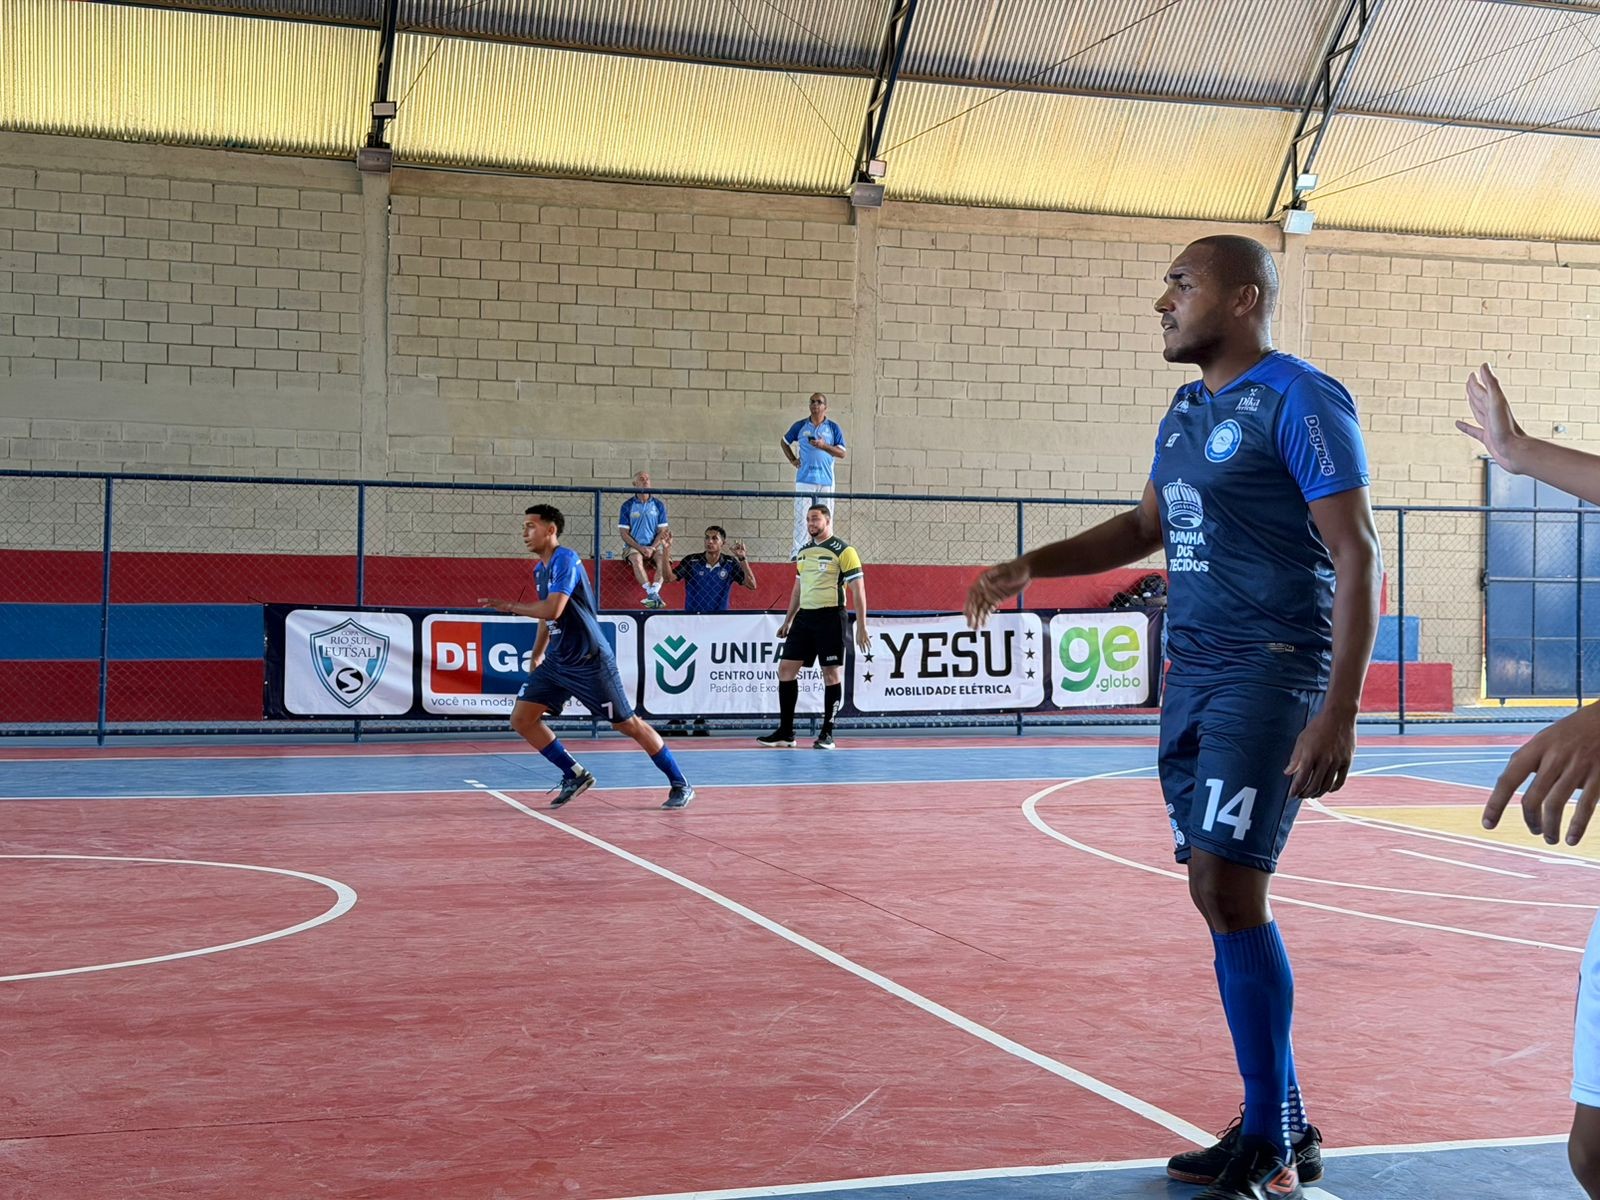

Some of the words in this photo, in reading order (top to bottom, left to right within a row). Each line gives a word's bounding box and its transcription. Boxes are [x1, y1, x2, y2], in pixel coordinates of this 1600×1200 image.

[1168, 558, 1210, 573] TECIDOS
[330, 636, 350, 646] RIO
[350, 636, 370, 646] SUL
[324, 645, 376, 658] FUTSAL
[436, 641, 478, 672] Di
[880, 630, 1015, 679] YESU
[1059, 625, 1140, 692] ge
[709, 670, 755, 680] CENTRO
[709, 683, 744, 693] Padrão
[745, 683, 758, 693] de
[884, 684, 957, 697] MOBILIDADE
[959, 682, 1012, 695] ELÉTRICA
[430, 696, 460, 706] você
[462, 698, 477, 706] na
[601, 701, 614, 720] 7
[1201, 778, 1259, 841] 14
